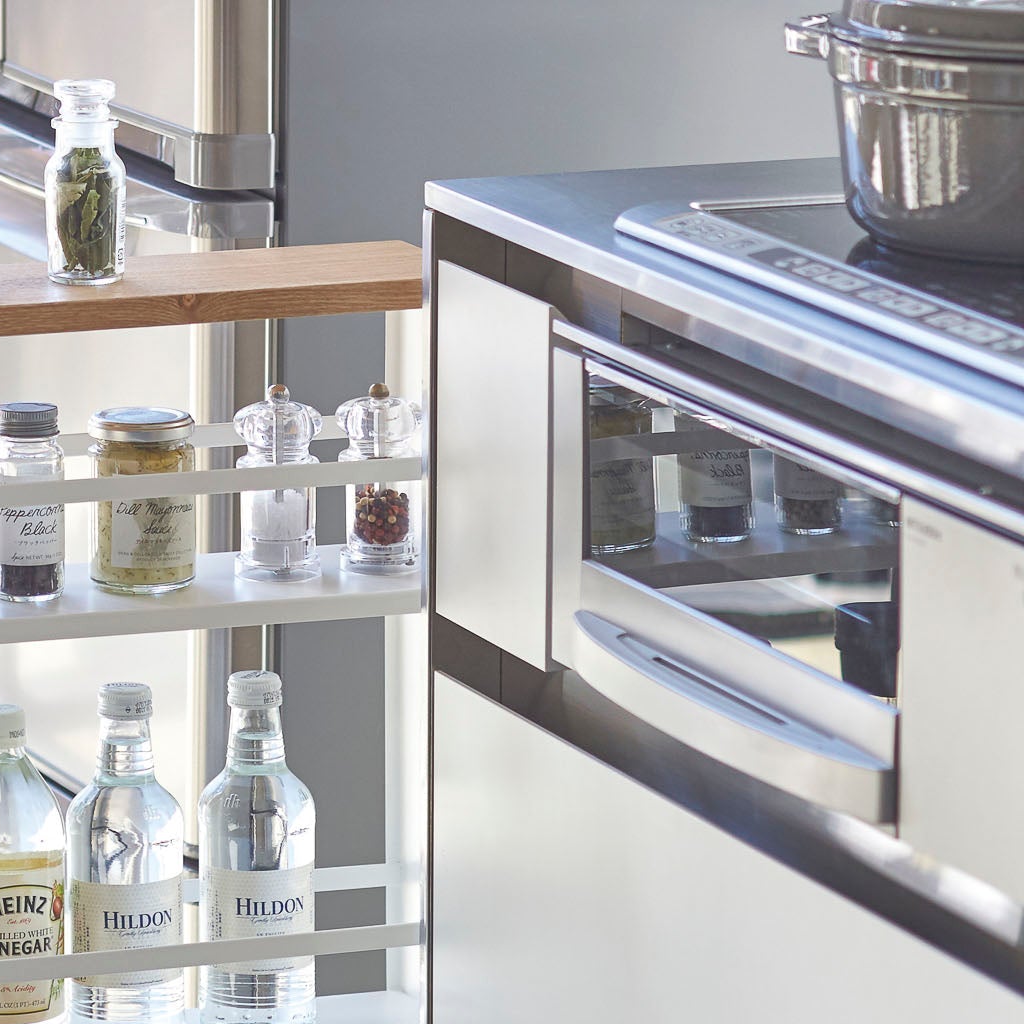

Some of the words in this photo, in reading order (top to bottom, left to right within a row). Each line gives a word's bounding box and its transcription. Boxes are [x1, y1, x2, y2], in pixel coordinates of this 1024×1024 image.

[116, 502, 142, 516] Dill
[20, 519, 57, 536] Black
[28, 927, 54, 938] WHITE
